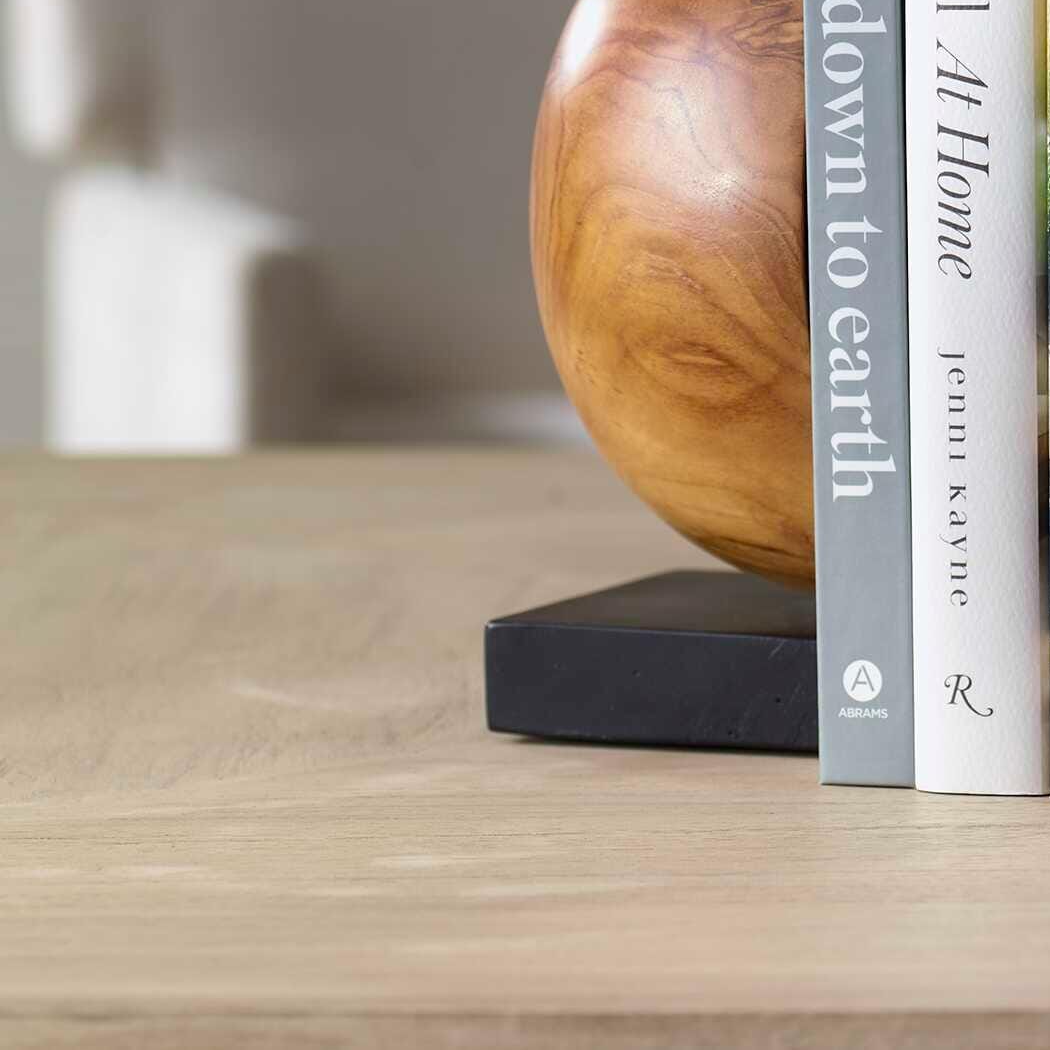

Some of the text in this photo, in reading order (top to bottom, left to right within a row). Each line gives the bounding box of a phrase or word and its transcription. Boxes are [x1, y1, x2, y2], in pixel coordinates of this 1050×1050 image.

[935, 38, 990, 111] At
[936, 120, 990, 281] Home
[825, 214, 884, 290] to
[827, 305, 897, 504] earth
[838, 707, 889, 719] ABRAMS
[943, 674, 994, 717] R
